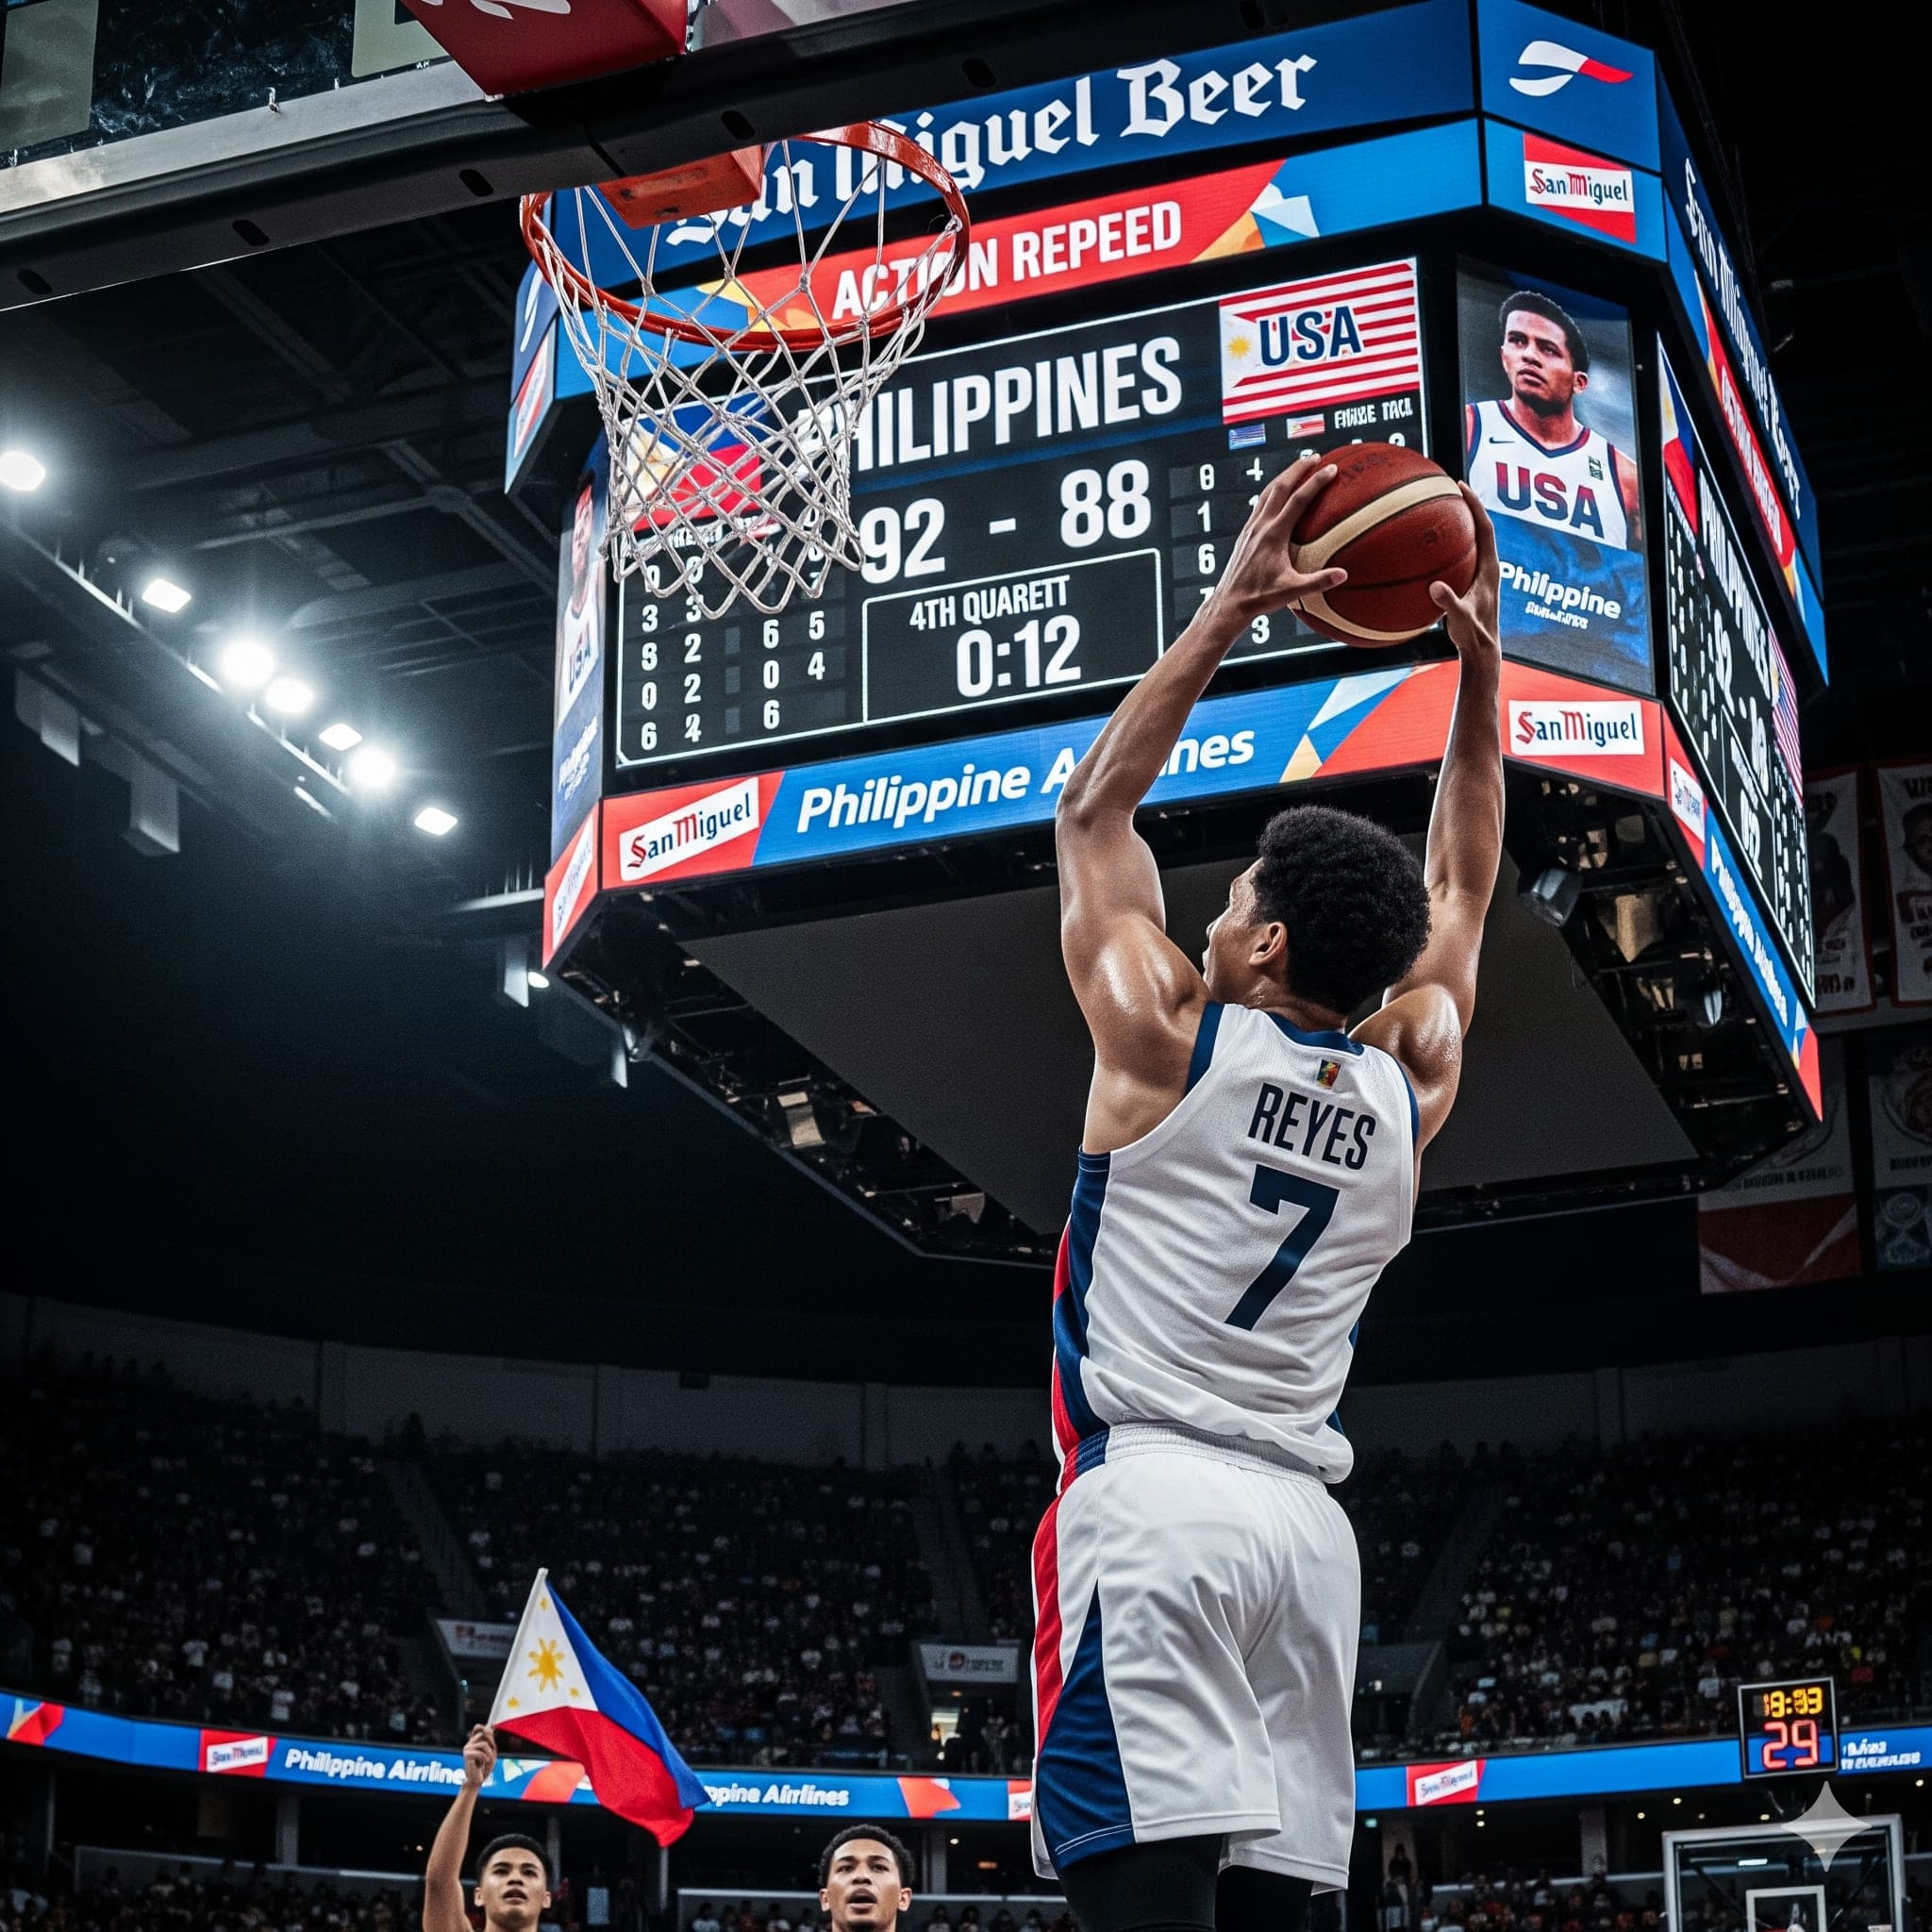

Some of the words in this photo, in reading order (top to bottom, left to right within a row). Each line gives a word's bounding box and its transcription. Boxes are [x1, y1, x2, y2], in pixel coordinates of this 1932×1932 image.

[665, 158, 819, 245] an
[1116, 55, 1318, 139] Beer
[831, 238, 997, 321] ACTION
[1012, 200, 1181, 279] REPEED
[1259, 305, 1363, 367] USA
[796, 337, 1183, 481] PHILIPPINES
[859, 498, 946, 585] 92
[1059, 459, 1152, 548] 88
[1197, 501, 1211, 532] 1
[1496, 462, 1605, 539] USA
[1198, 543, 1216, 575] 6
[641, 605, 658, 632] 3
[909, 596, 956, 631] 4TH
[962, 575, 1071, 621] QUARETT
[1251, 614, 1270, 644] 3
[684, 633, 702, 663] 2
[763, 620, 779, 649] 6
[808, 610, 825, 641] 5
[956, 614, 1082, 698] 0:12
[684, 674, 702, 704] 2
[763, 660, 780, 690] 0
[808, 652, 825, 680] 4
[641, 722, 658, 750] 6
[763, 700, 780, 729] 6
[797, 763, 1031, 834] Philippine
[1248, 1083, 1376, 1171] REYES
[1223, 1164, 1341, 1331] 7
[1762, 1719, 1819, 1770] 29
